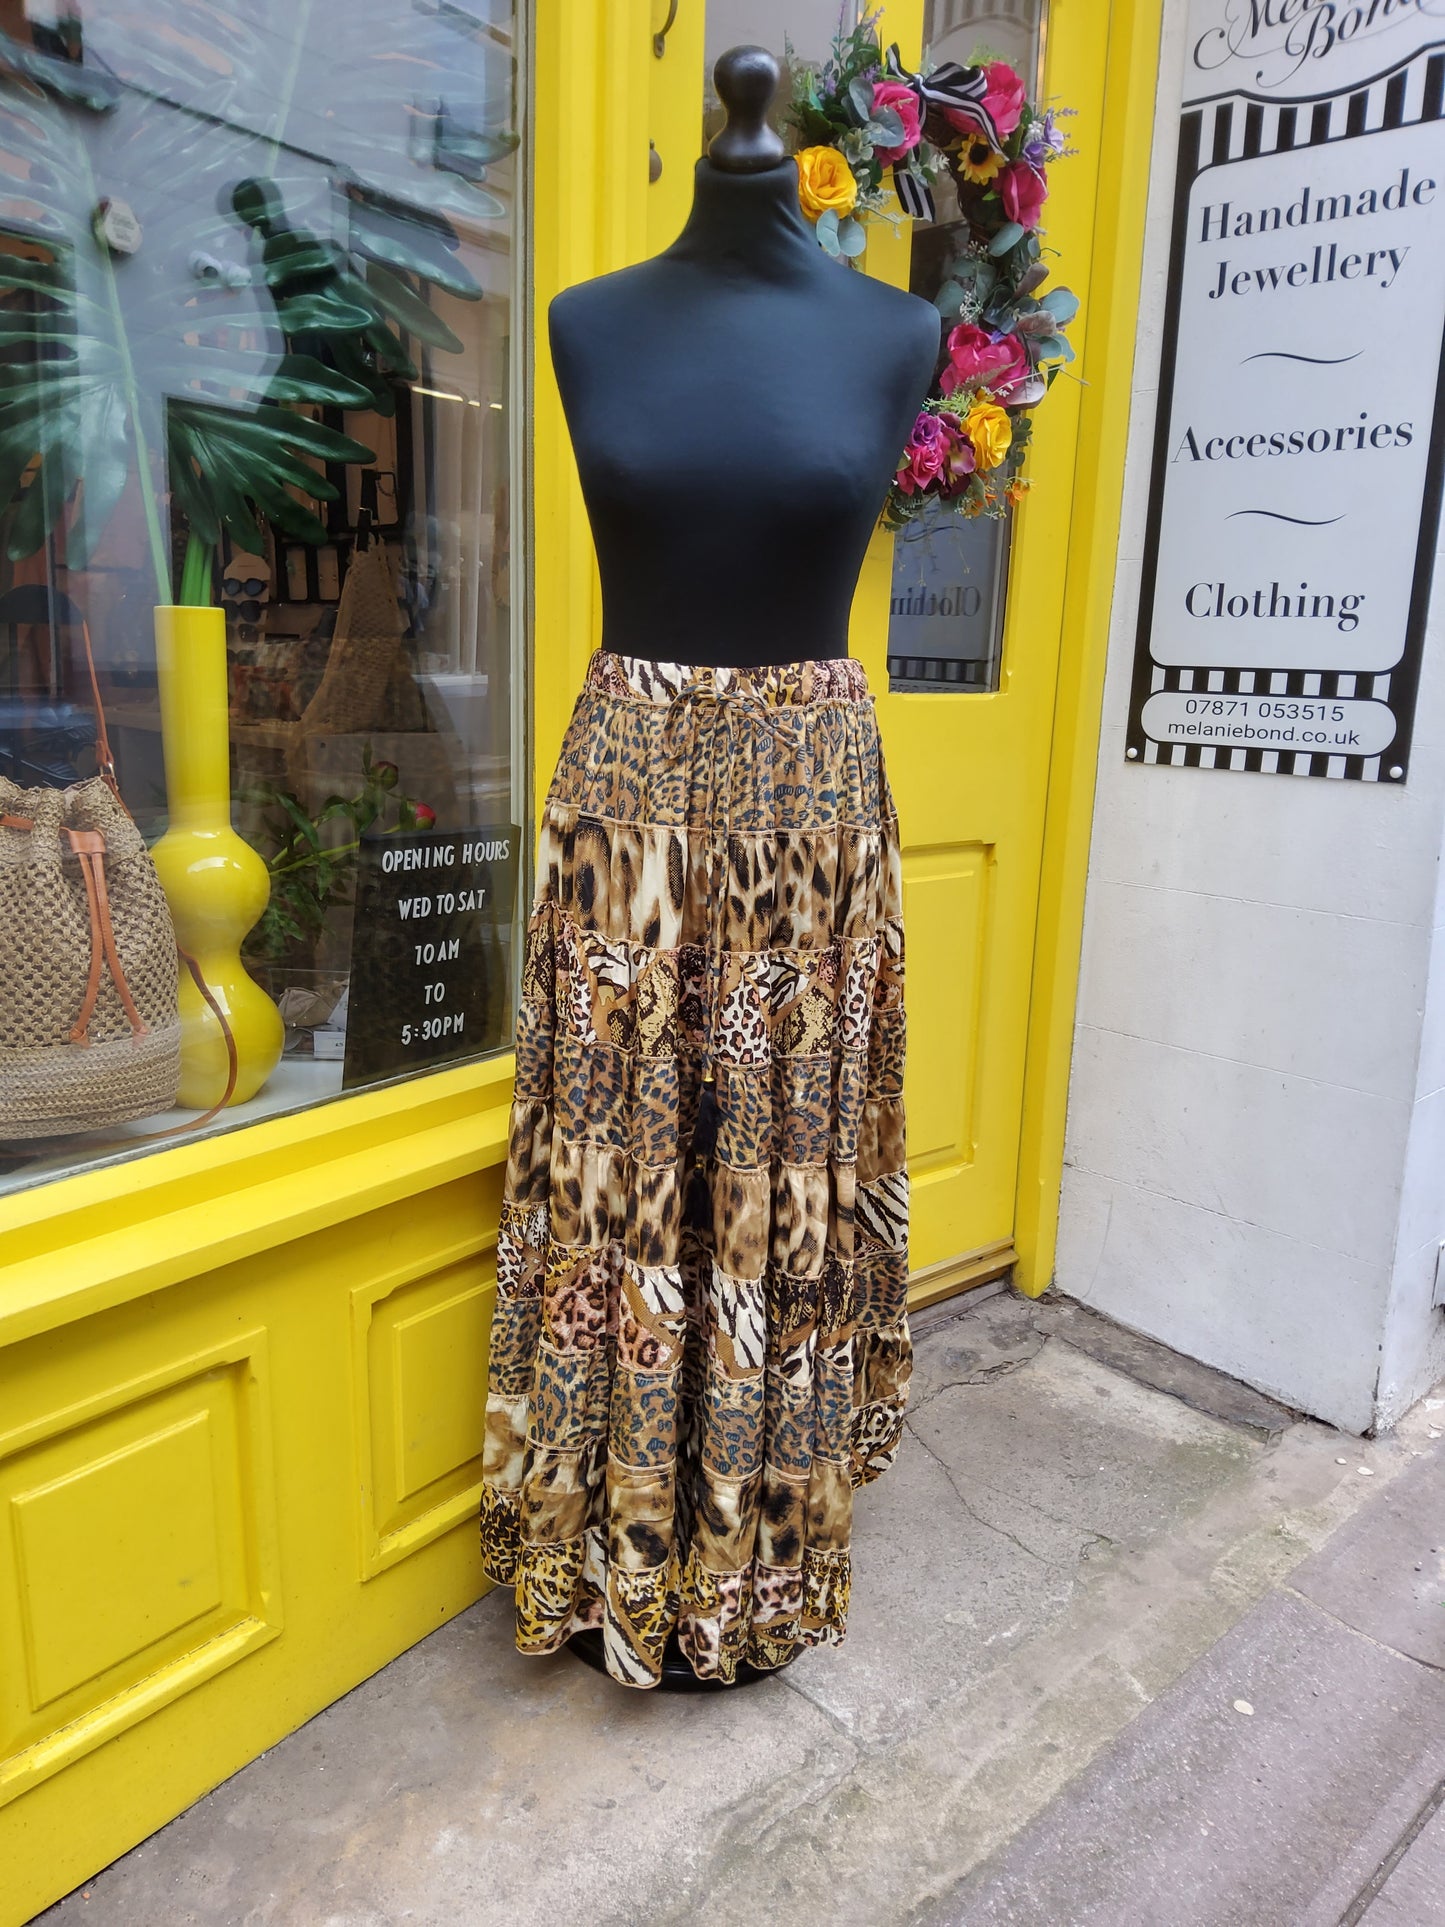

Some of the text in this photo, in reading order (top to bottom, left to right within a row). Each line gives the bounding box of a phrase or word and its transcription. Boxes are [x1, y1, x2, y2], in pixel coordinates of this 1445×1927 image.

[1256, 0, 1428, 88] Bon
[1197, 168, 1436, 243] Handmade
[1208, 243, 1411, 299] Jewellery
[1171, 412, 1413, 462] Accessories
[1185, 582, 1365, 632] Clothing
[1185, 700, 1345, 722] 07871 053515
[1168, 722, 1361, 745] melaniebond.co.uk
[382, 840, 510, 873] OPENING HOURS
[398, 889, 486, 920] WED TO SAT
[424, 982, 446, 1005] TO
[401, 1012, 465, 1045] 5:30PM
